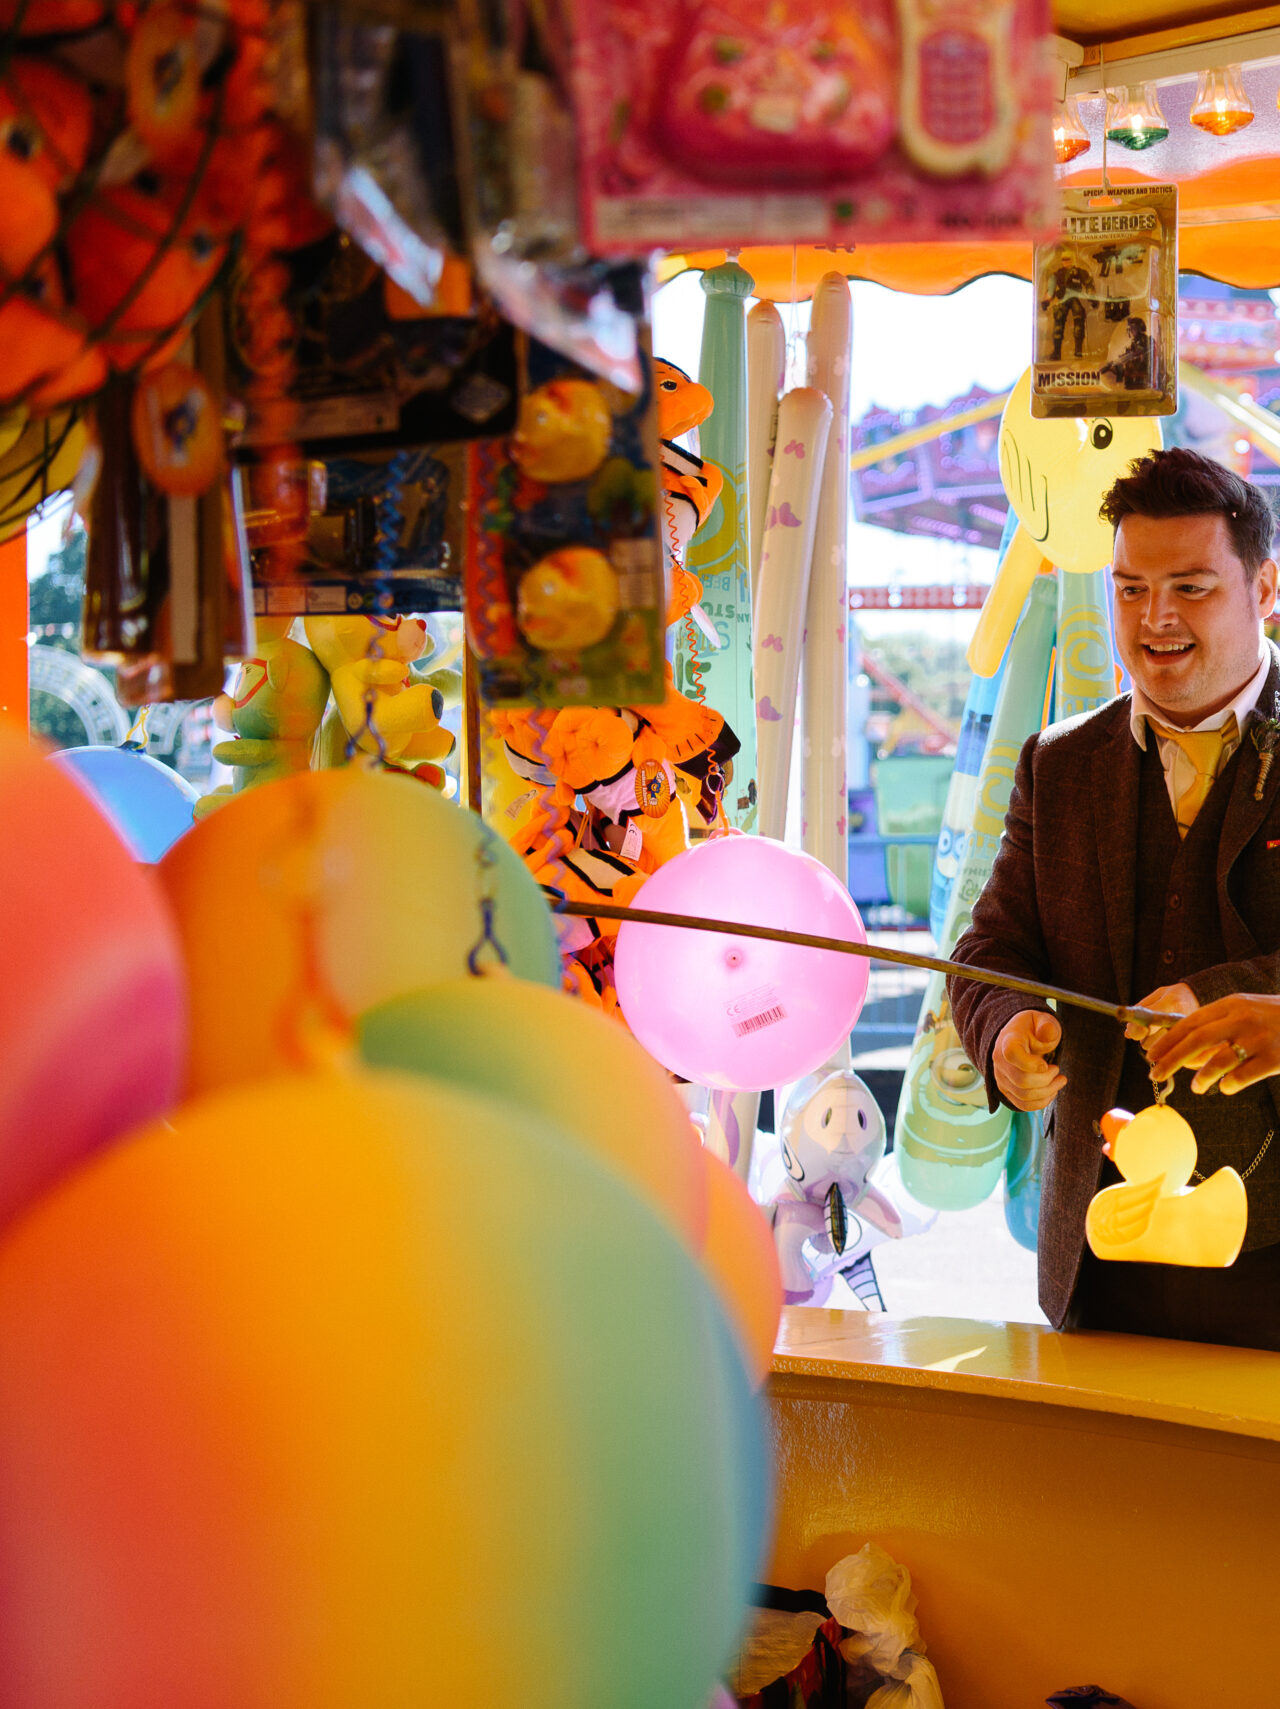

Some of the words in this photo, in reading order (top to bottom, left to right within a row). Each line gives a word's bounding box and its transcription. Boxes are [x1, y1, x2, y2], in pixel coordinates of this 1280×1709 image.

[1107, 187, 1135, 196] WEAPONS
[1148, 186, 1173, 194] TACTICS
[1061, 215, 1100, 234] LITE
[1101, 214, 1156, 231] HEROES
[1038, 371, 1100, 387] MISSION
